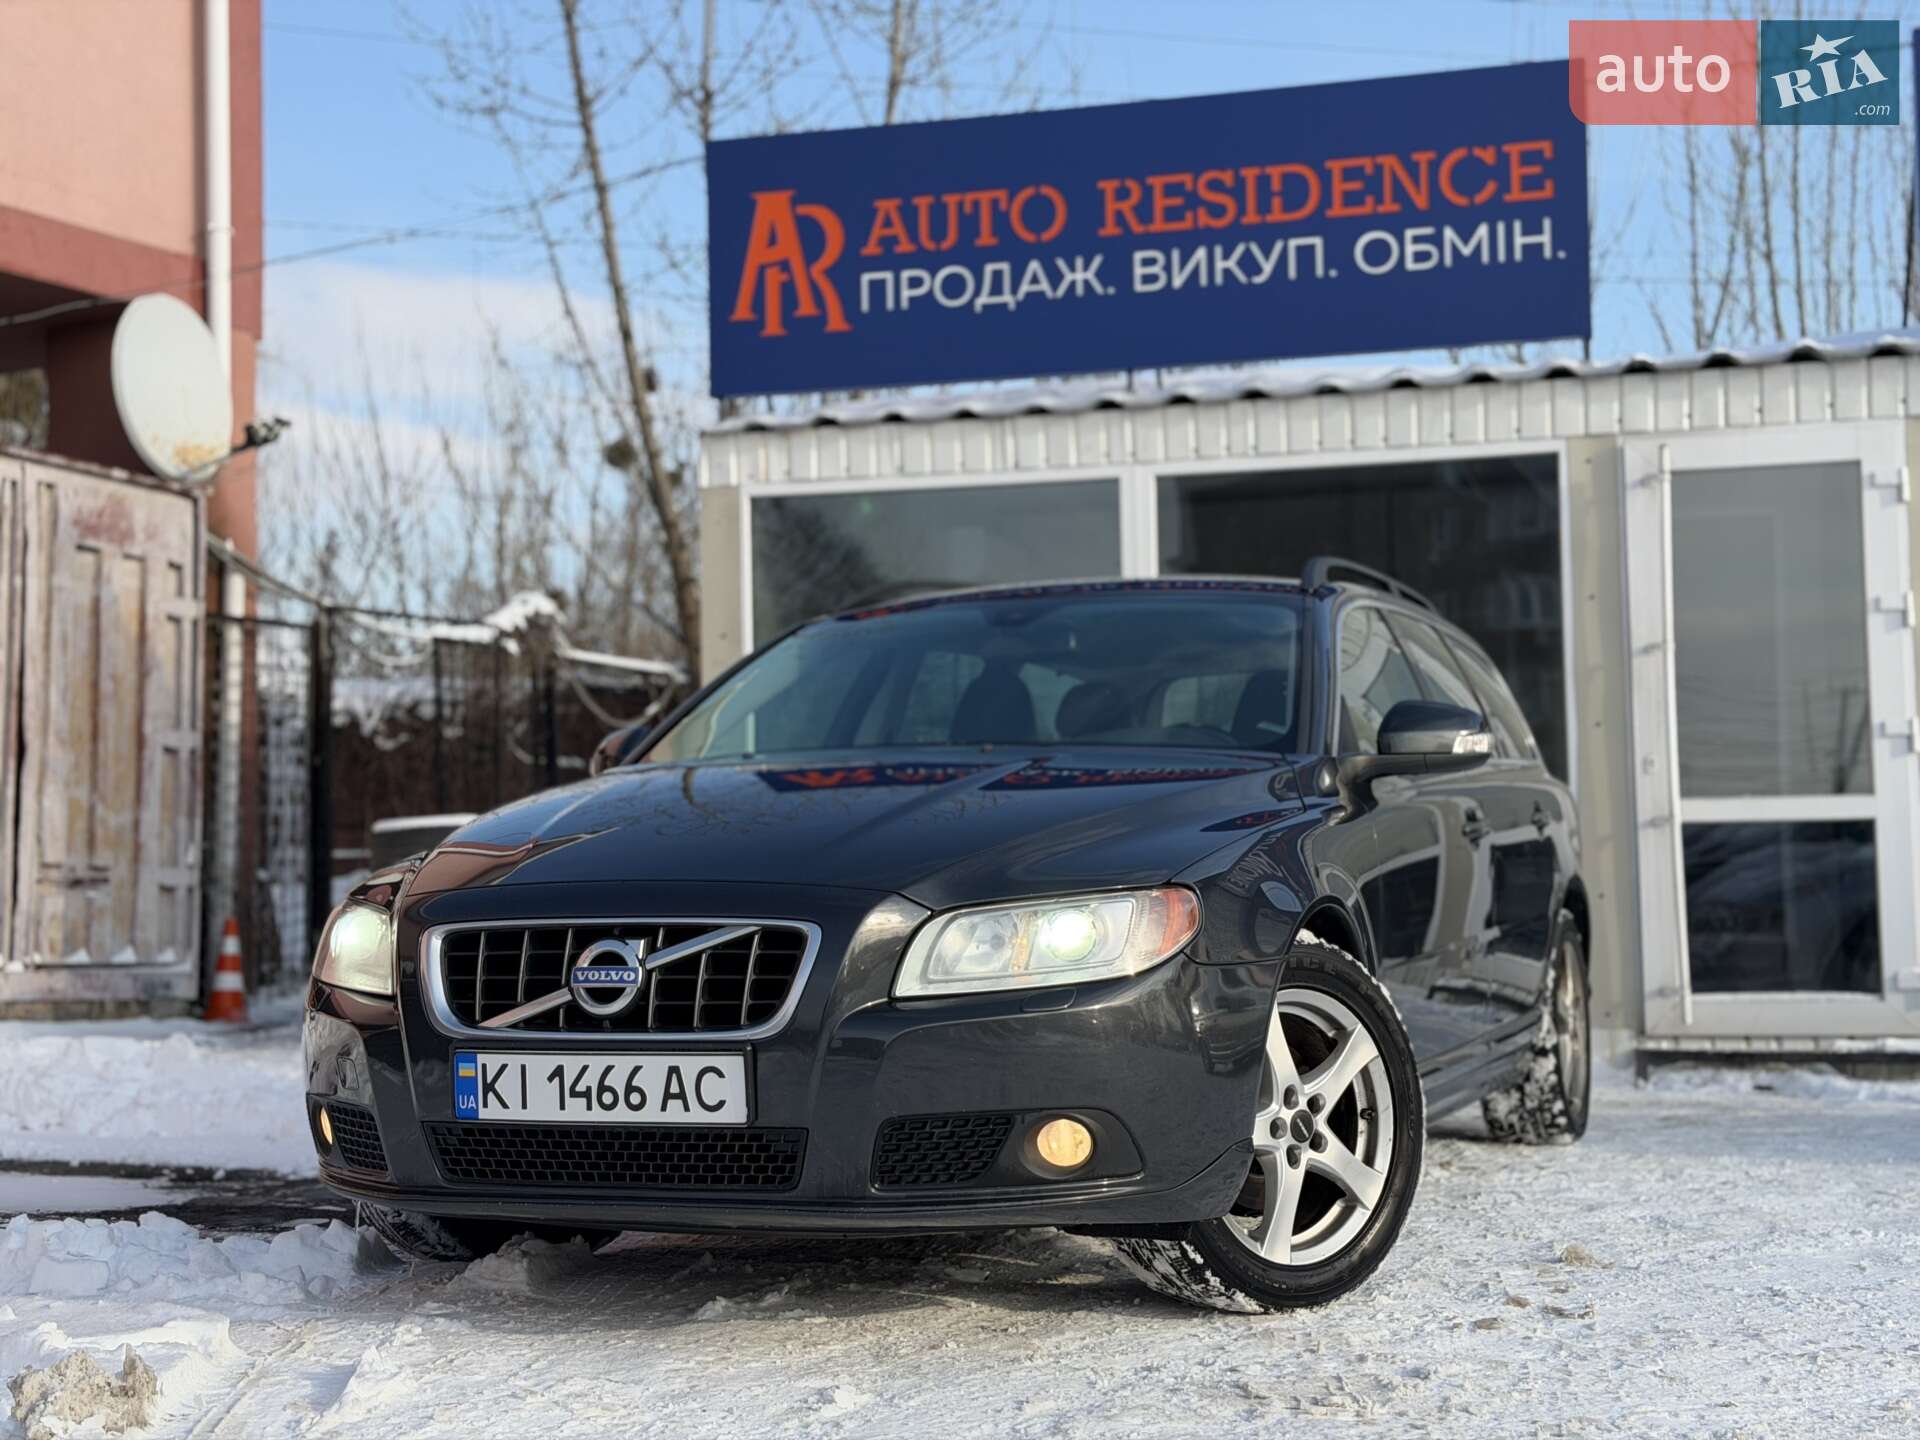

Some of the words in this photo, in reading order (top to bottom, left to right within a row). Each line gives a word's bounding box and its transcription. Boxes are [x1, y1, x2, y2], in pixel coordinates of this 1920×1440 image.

[860, 186, 1067, 256] AUTO
[1097, 140, 1555, 237] RESIDENCE
[859, 253, 1117, 314] ПРОДАЖ.
[1131, 235, 1339, 294] ВИКУП.
[1353, 216, 1568, 276] ОБМІН.
[575, 970, 636, 981] VOLVO
[459, 1095, 477, 1110] UA
[480, 1062, 529, 1110] KI
[546, 1064, 648, 1112] 1466
[660, 1065, 727, 1113] AC
